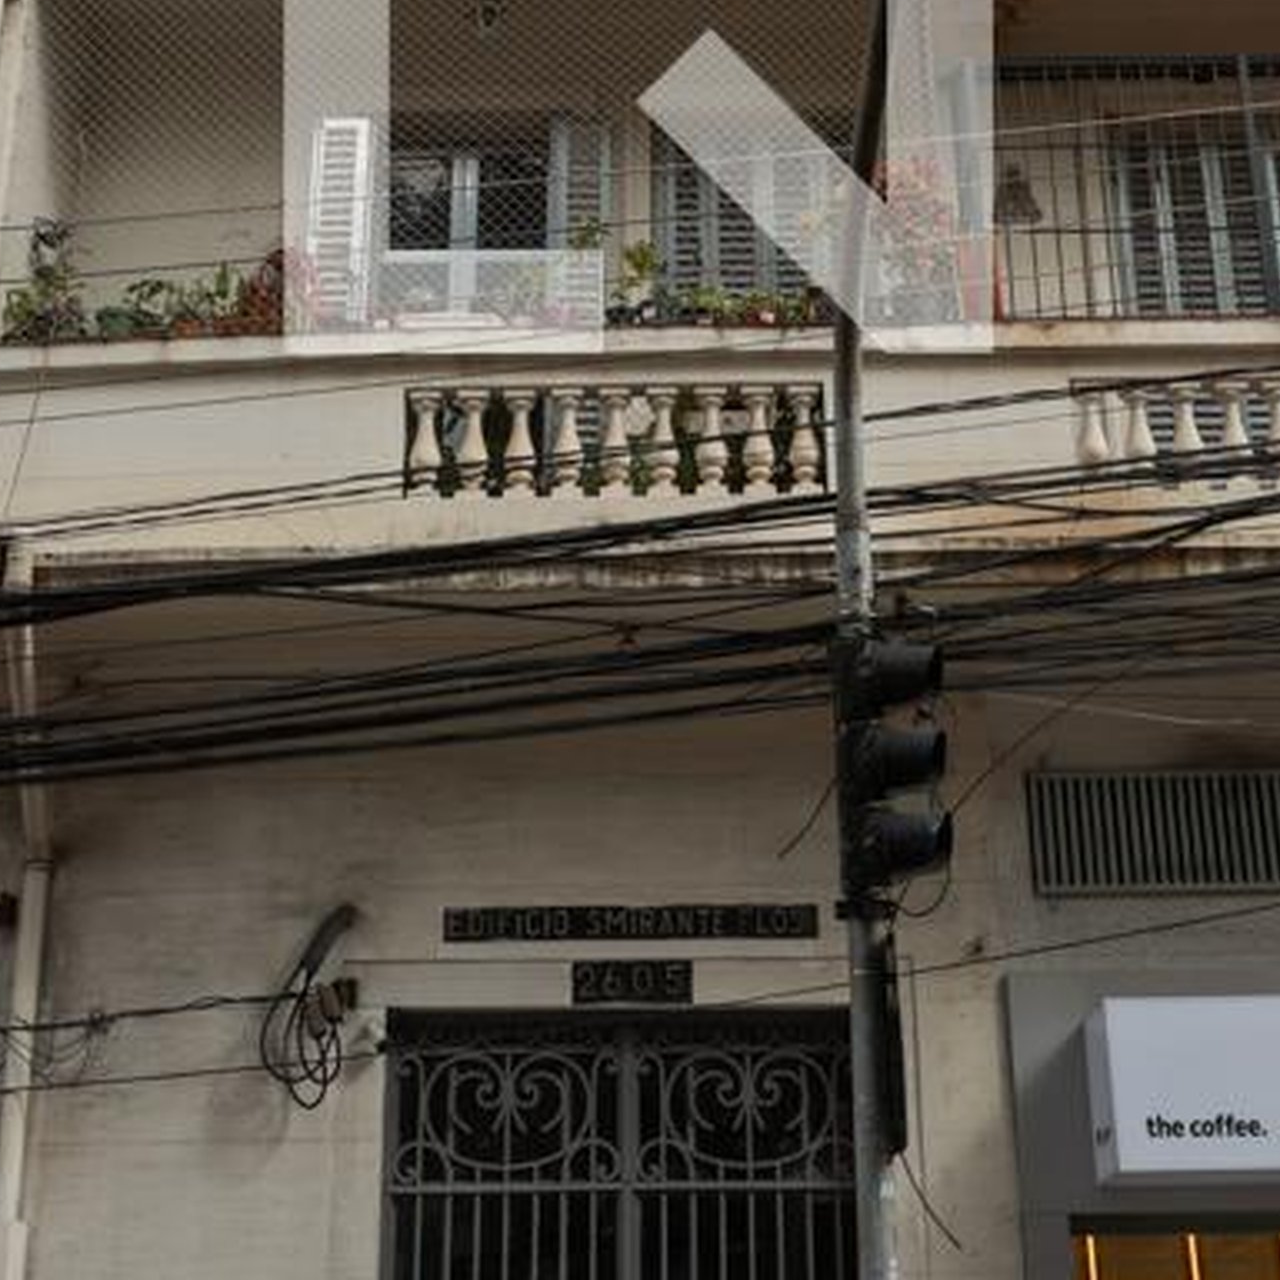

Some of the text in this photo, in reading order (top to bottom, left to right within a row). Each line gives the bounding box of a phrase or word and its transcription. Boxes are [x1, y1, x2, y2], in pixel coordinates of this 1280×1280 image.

[575, 963, 687, 998] 2605
[1146, 1114, 1268, 1138] the coffee.
